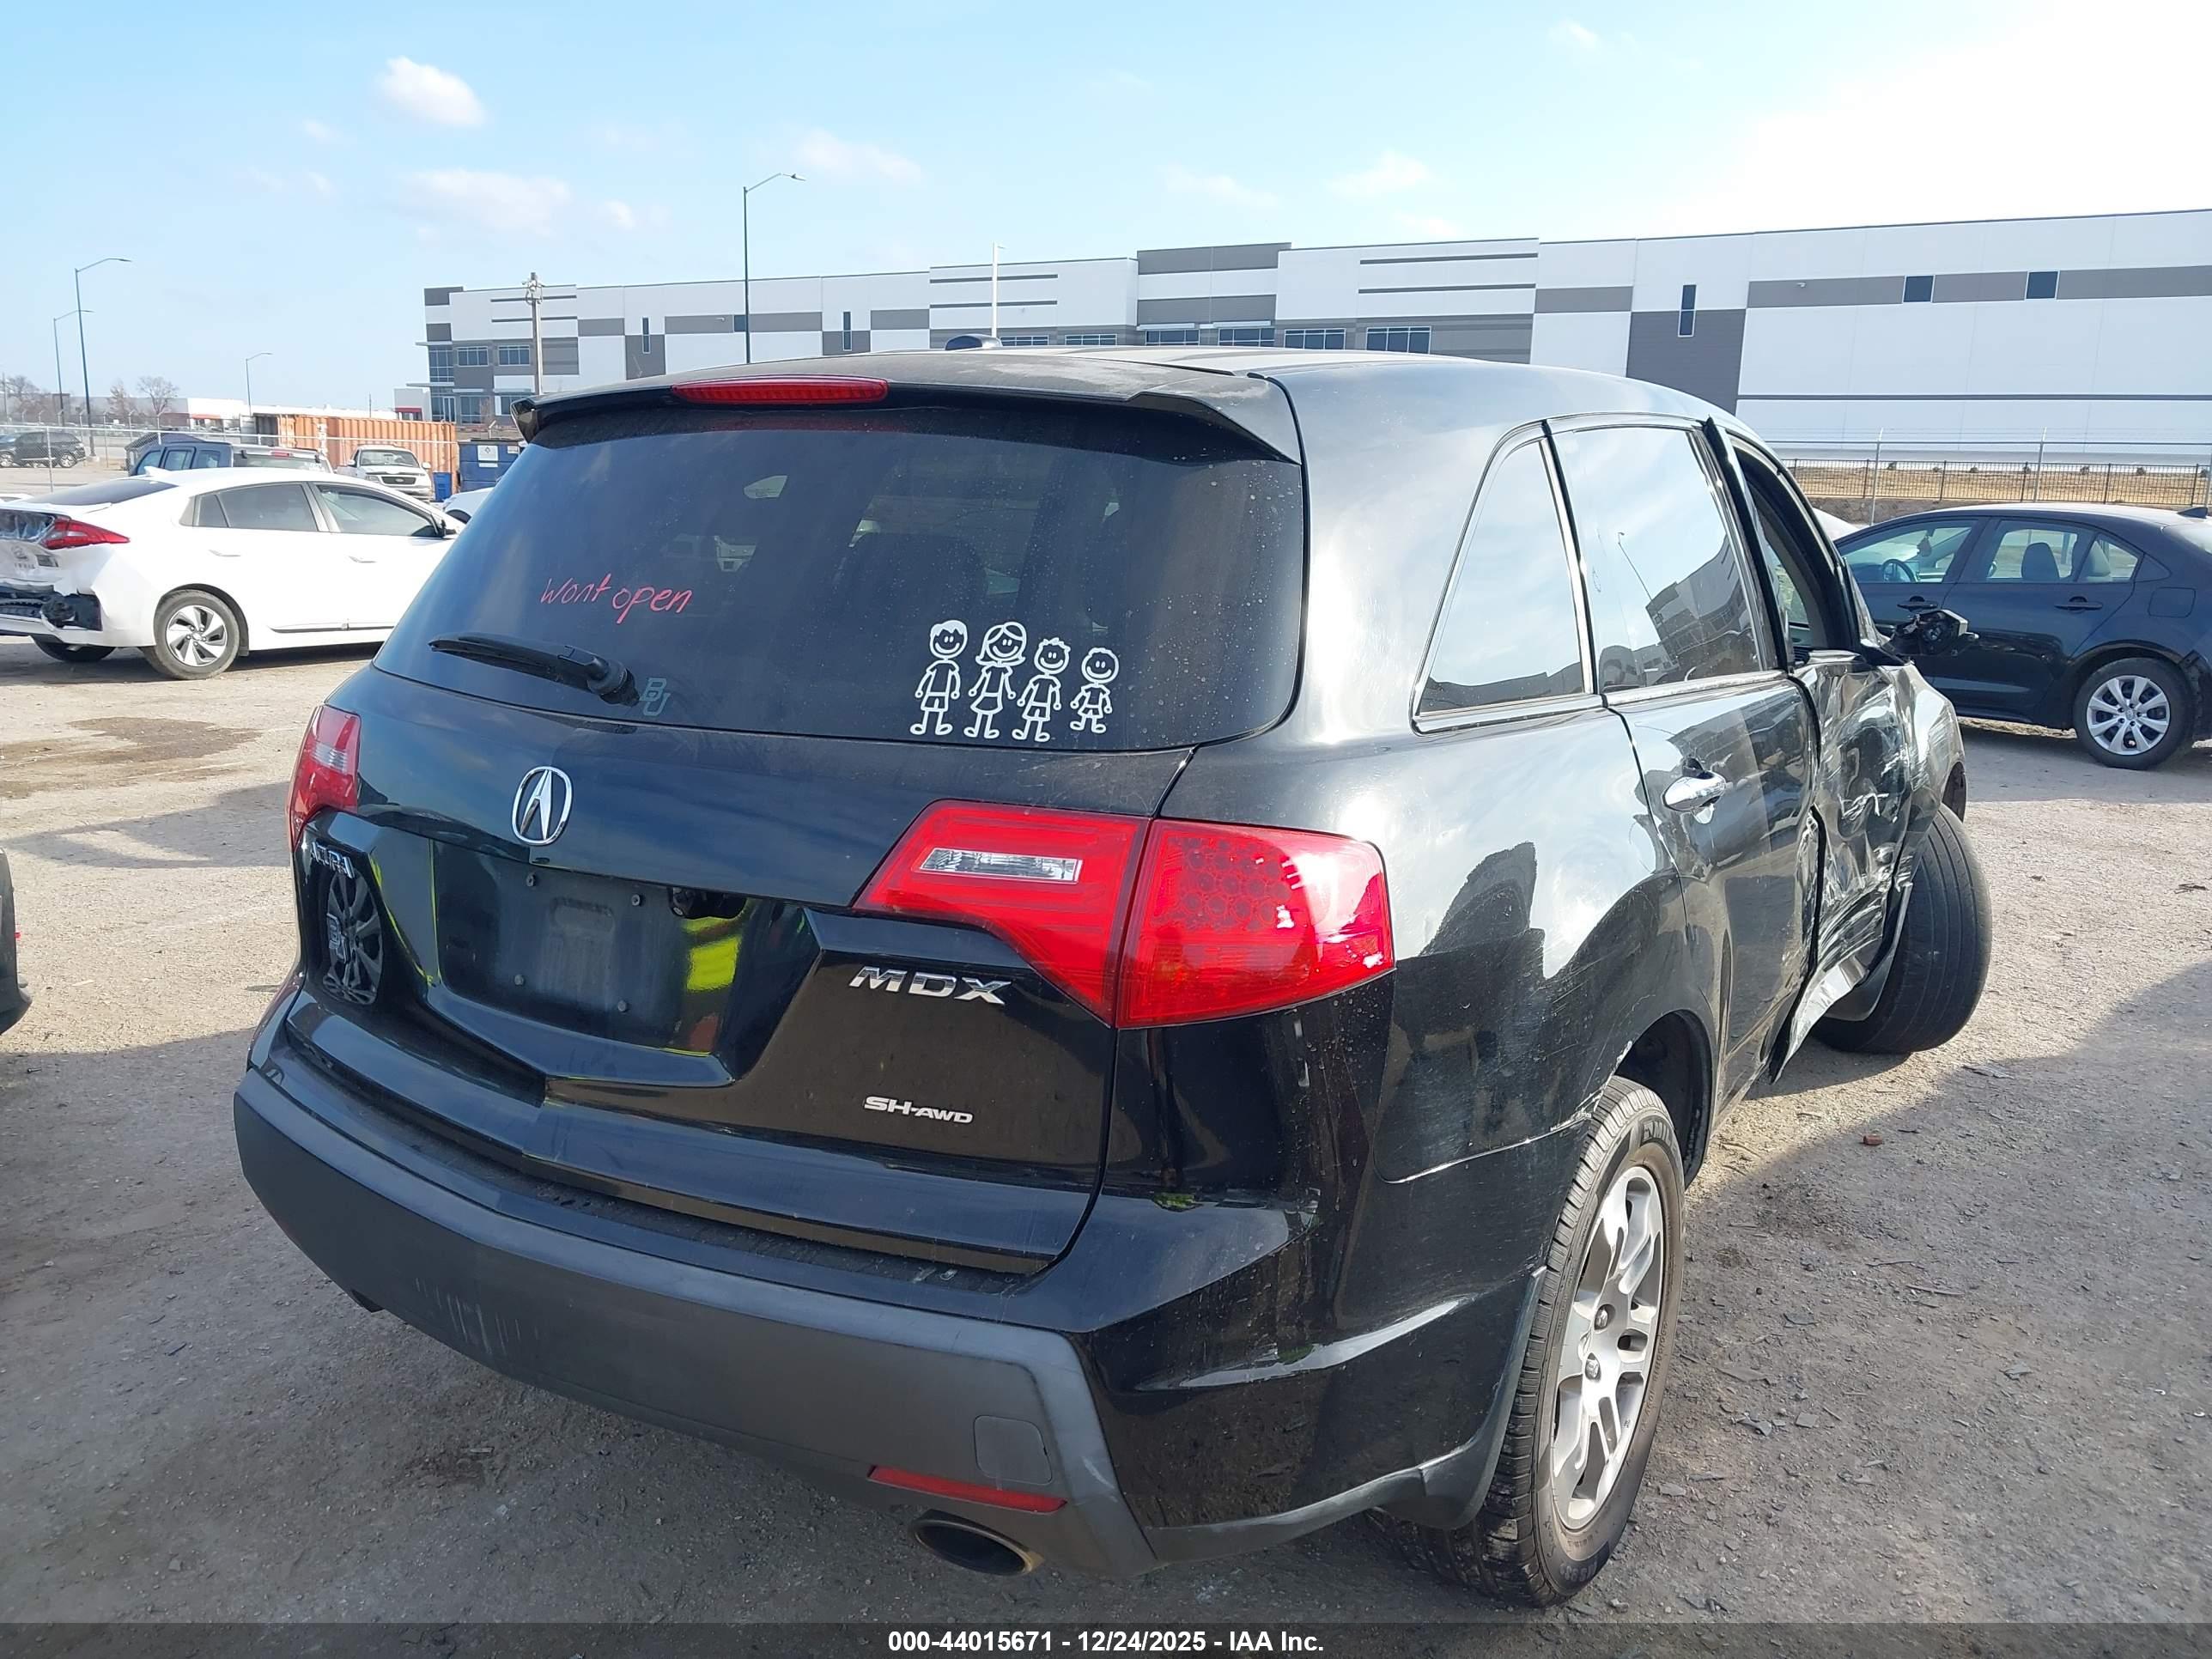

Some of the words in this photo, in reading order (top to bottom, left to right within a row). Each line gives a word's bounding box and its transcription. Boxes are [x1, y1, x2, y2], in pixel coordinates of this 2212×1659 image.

[611, 586, 693, 624] open
[311, 841, 356, 879] ACURA
[849, 965, 1012, 1005] MDX
[863, 1095, 974, 1124] SH-AWD
